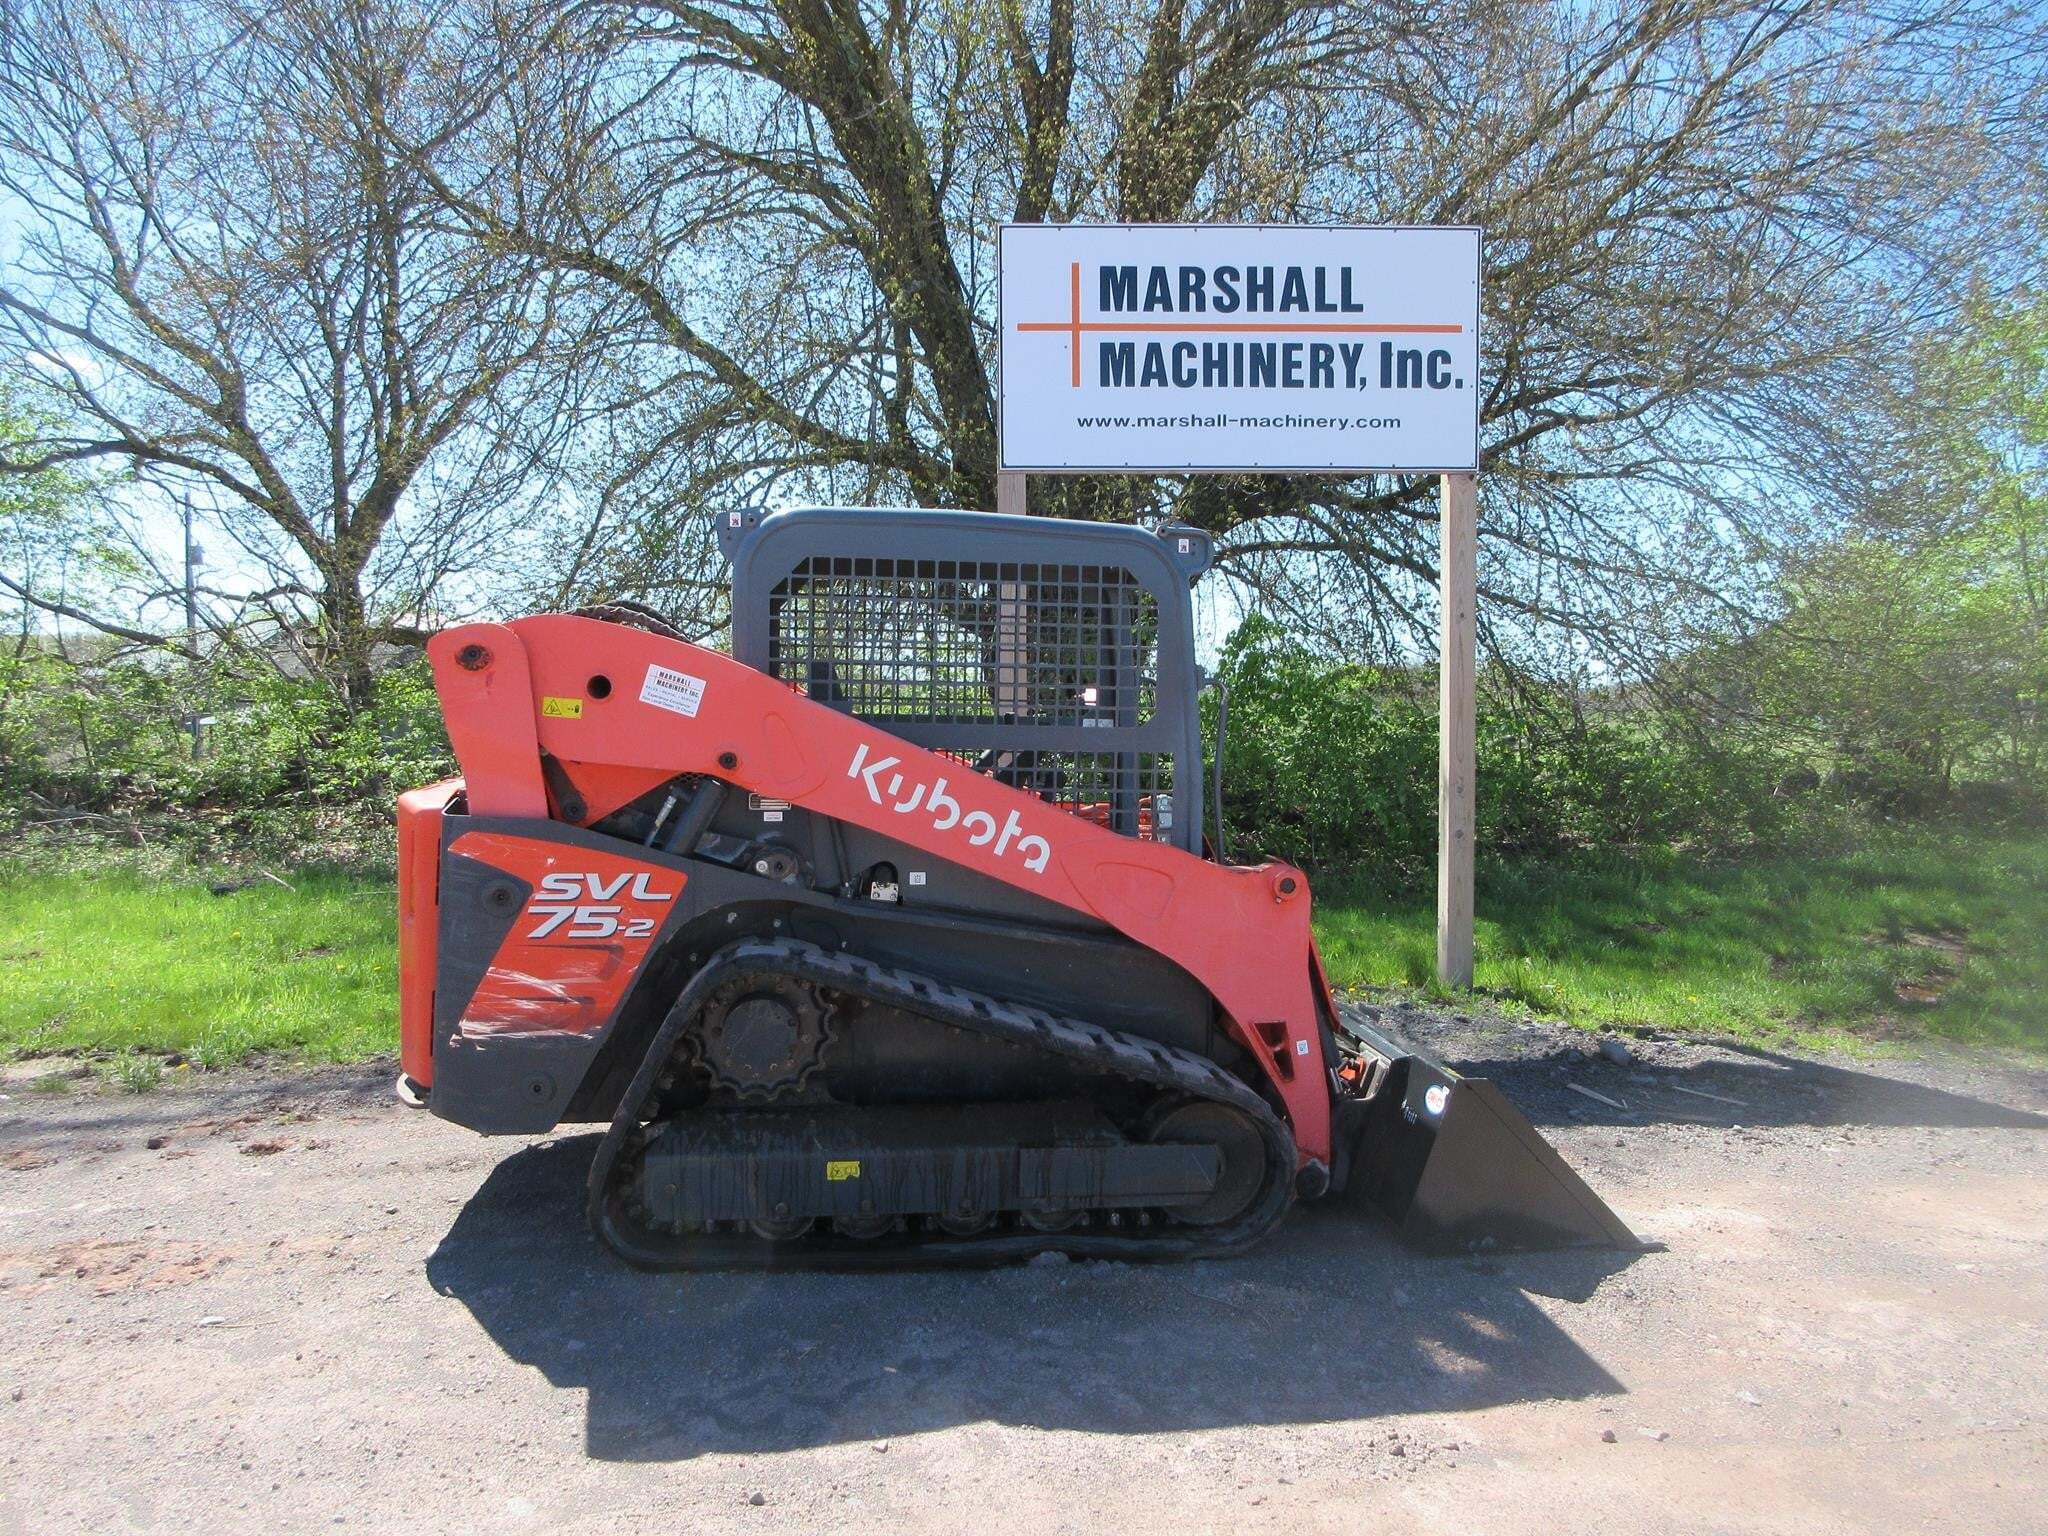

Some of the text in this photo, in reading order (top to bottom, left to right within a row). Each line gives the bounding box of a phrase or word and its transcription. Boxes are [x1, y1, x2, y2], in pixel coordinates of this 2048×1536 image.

[1099, 265, 1364, 313] MARSHALL
[1099, 340, 1464, 392] MACHINERY, Inc.
[1077, 414, 1401, 431] www.marshall-machinery.com
[847, 743, 1051, 874] Kubota
[534, 873, 672, 901] SVL
[527, 906, 655, 938] 75-2
